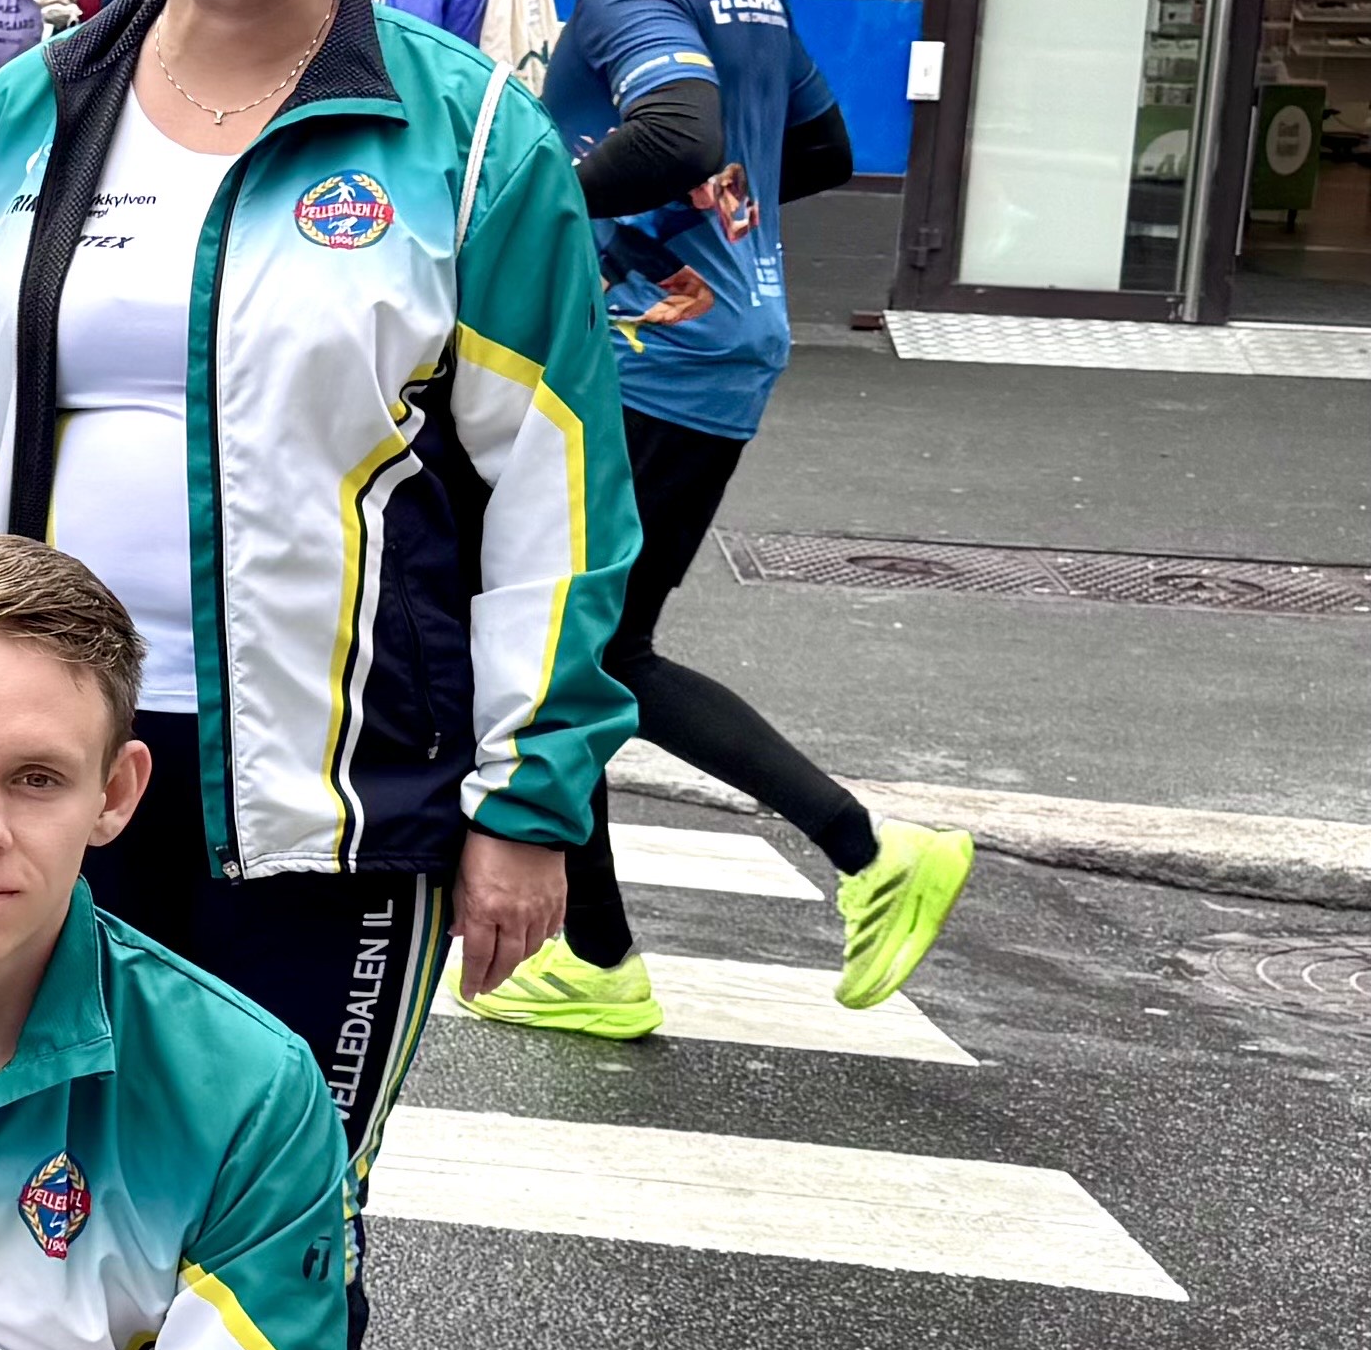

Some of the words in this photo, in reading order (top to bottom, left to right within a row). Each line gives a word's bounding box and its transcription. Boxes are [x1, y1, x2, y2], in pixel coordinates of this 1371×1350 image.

[300, 201, 371, 221] VELLEDALEN
[372, 206, 386, 220] IL
[362, 899, 393, 926] IL
